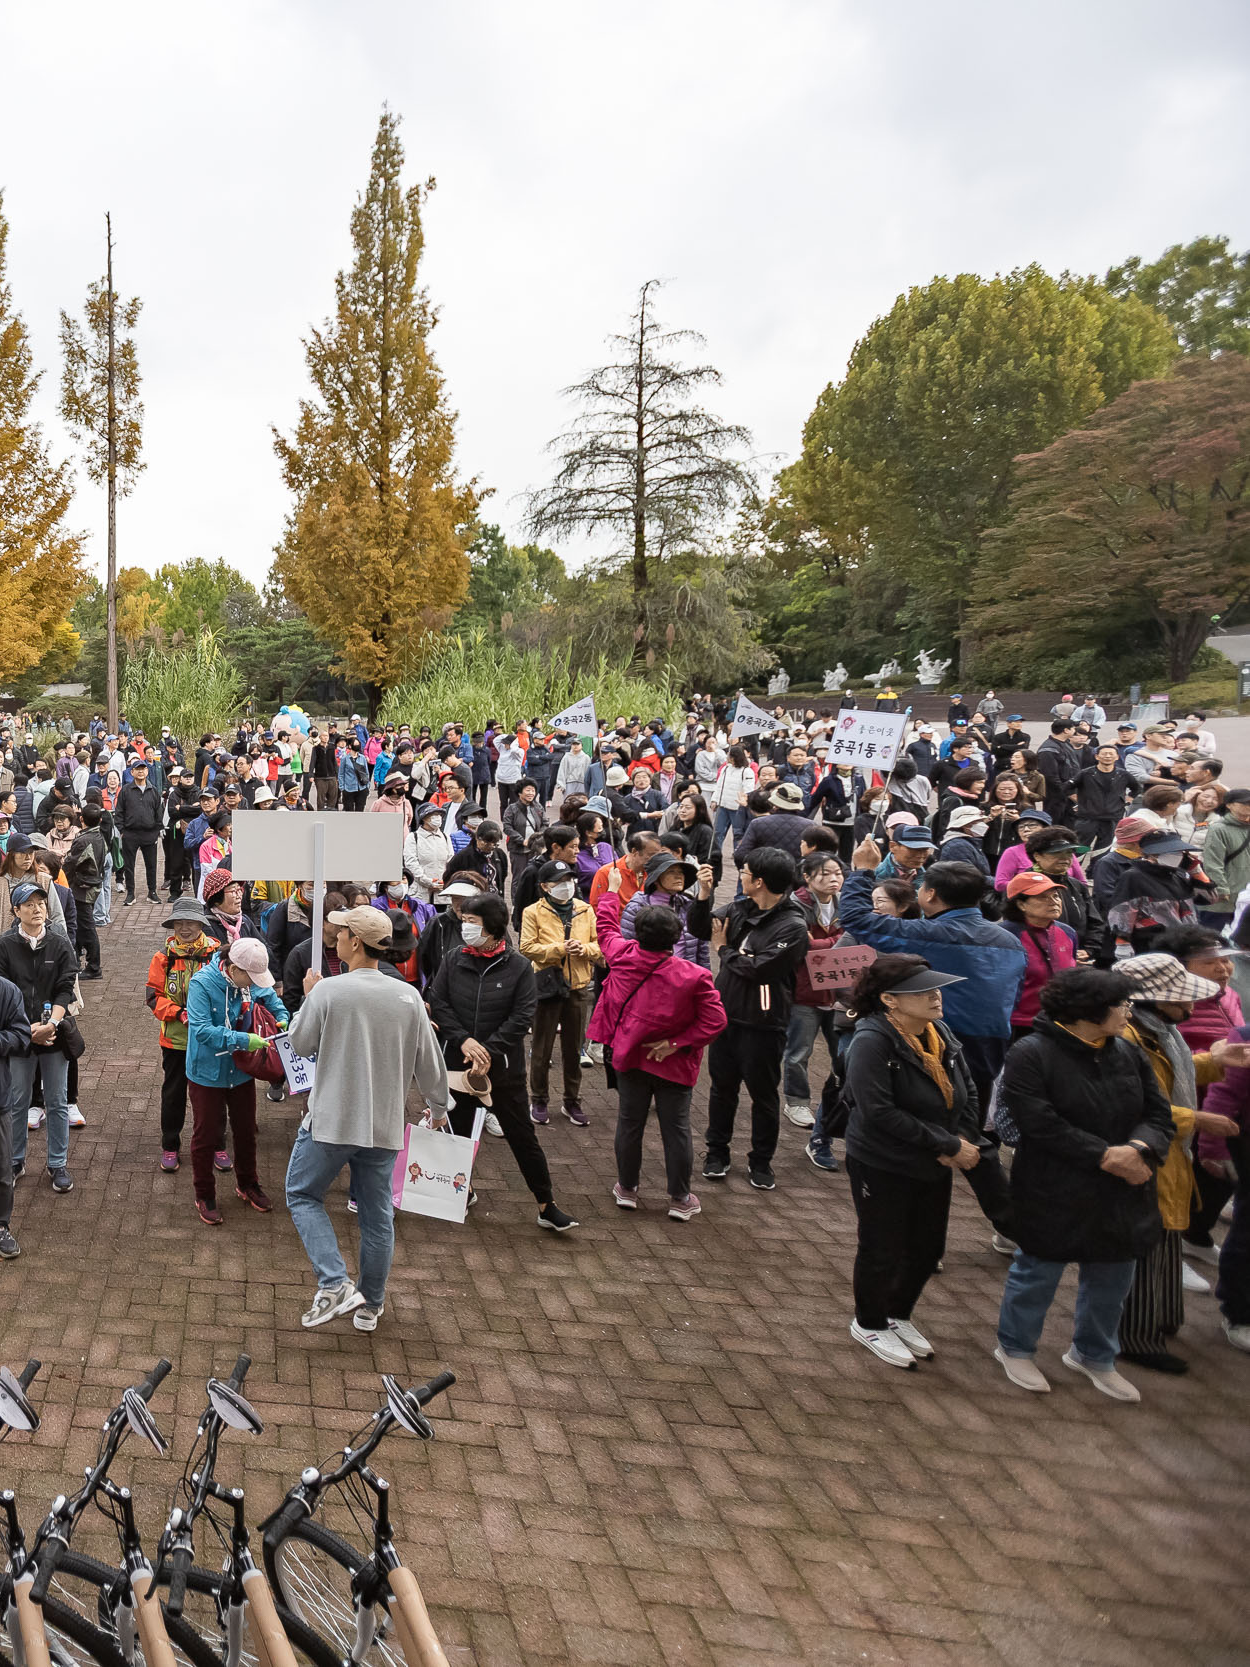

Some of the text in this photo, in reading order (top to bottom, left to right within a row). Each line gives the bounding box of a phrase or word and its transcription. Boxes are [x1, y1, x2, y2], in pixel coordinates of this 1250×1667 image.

[563, 713, 593, 726] 중곡2동
[746, 715, 777, 730] 중곡2동
[833, 739, 877, 759] 중곡1동
